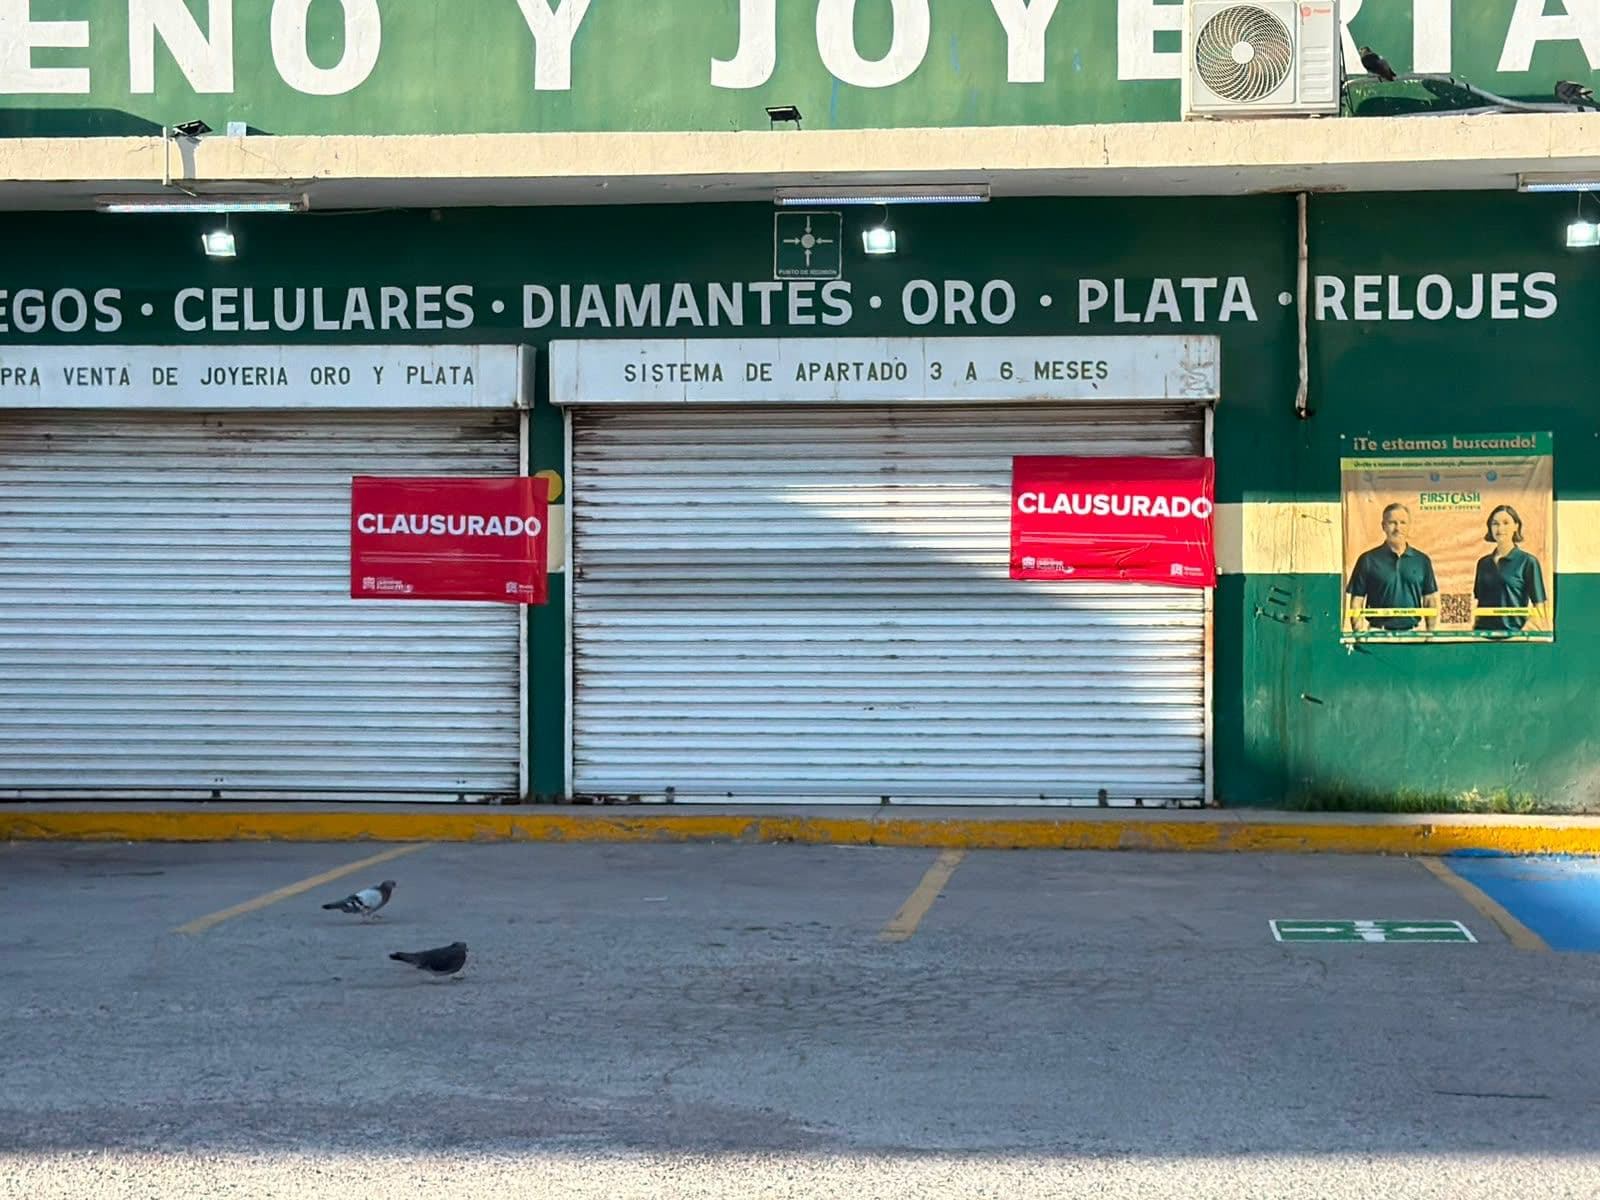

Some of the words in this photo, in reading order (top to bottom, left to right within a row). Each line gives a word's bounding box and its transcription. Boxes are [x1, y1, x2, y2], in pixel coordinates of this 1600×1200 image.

[517, 0, 591, 90] Y
[174, 284, 474, 331] CELULARES
[523, 280, 853, 328] DIAMANTES
[902, 279, 1016, 325] ORO
[1078, 277, 1258, 323] PLATA
[1314, 272, 1558, 320] RELOJES
[0, 367, 41, 386] PRA
[63, 367, 130, 386] VENTA
[152, 367, 178, 386] DE
[200, 366, 288, 386] JOYERIA
[310, 366, 351, 385] ORO
[373, 366, 384, 385] Y
[406, 365, 474, 385] PLATA
[624, 363, 723, 382] SISTEMA
[746, 362, 772, 382] DE
[795, 362, 907, 382] APARTADO
[930, 361, 942, 381] 3
[965, 361, 977, 381] A
[1000, 361, 1013, 380] 6
[1034, 360, 1108, 380] MESES
[1353, 437, 1377, 450] ¡Te
[1382, 438, 1448, 450] estamos
[1453, 434, 1537, 449] buscando!
[1017, 492, 1213, 519] CLAUSURADO
[357, 513, 542, 537] CLAUSURADO
